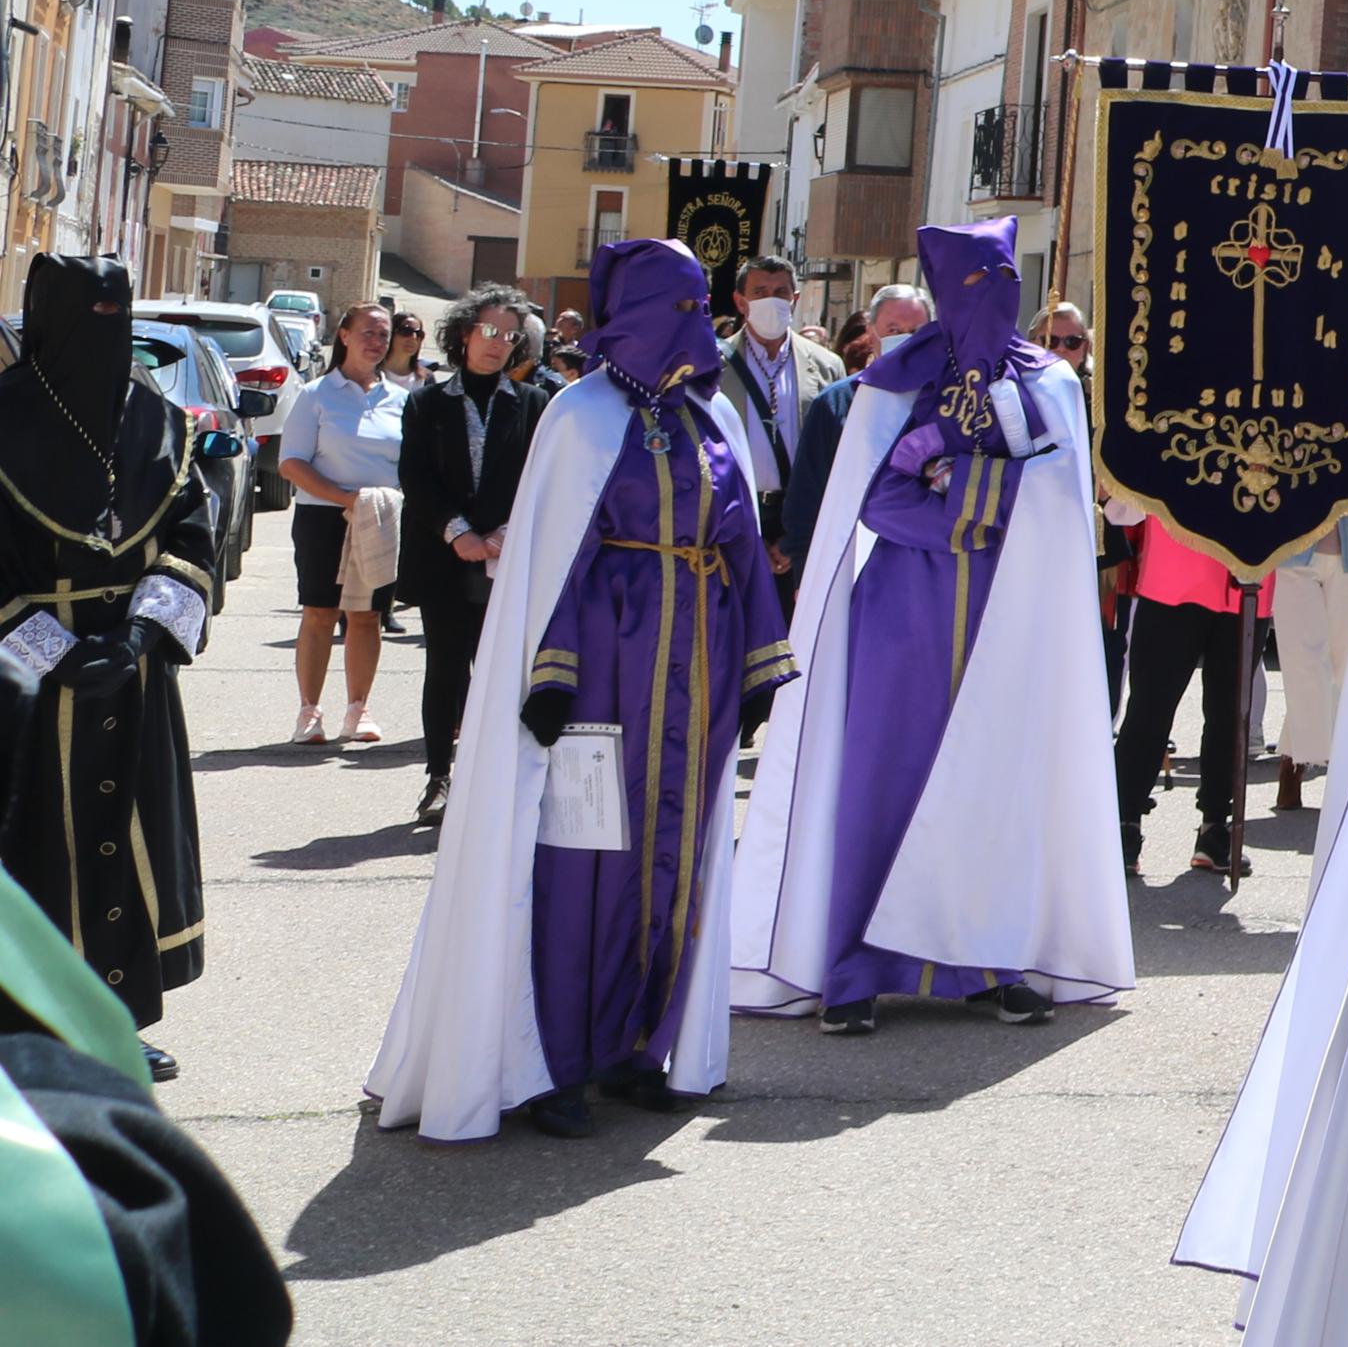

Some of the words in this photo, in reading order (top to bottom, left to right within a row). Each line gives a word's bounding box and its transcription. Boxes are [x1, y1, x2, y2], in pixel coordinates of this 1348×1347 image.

[707, 191, 747, 218] SEÑORA
[676, 196, 705, 244] NUESTRA
[739, 220, 751, 237] DE
[738, 237, 750, 251] LA
[1199, 383, 1304, 409] salud
